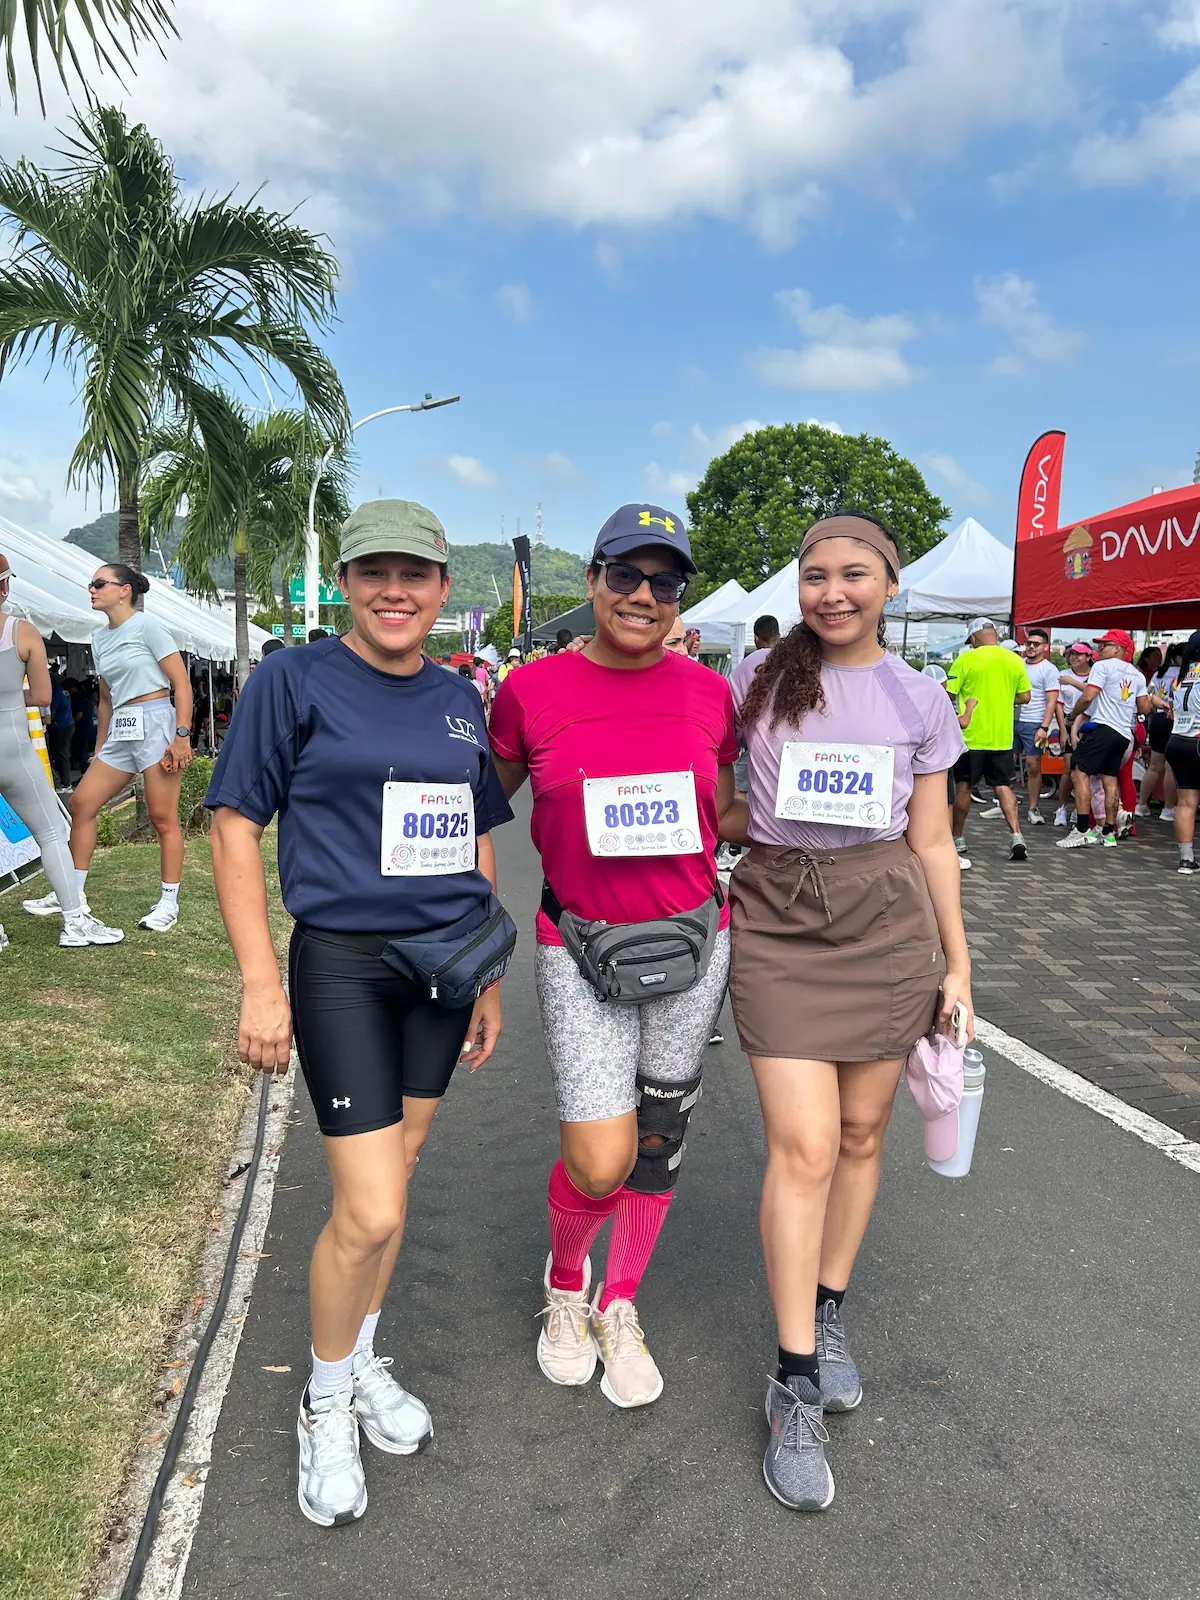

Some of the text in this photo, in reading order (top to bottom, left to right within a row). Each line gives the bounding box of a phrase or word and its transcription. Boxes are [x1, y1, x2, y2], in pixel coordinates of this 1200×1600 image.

[814, 752, 861, 763] FANLYC
[797, 768, 874, 795] 80324
[617, 784, 662, 796] FANLYC
[421, 794, 463, 805] FANLYC
[604, 799, 680, 828] 80323
[403, 812, 468, 839] 80325
[649, 1087, 687, 1100] Mueller
